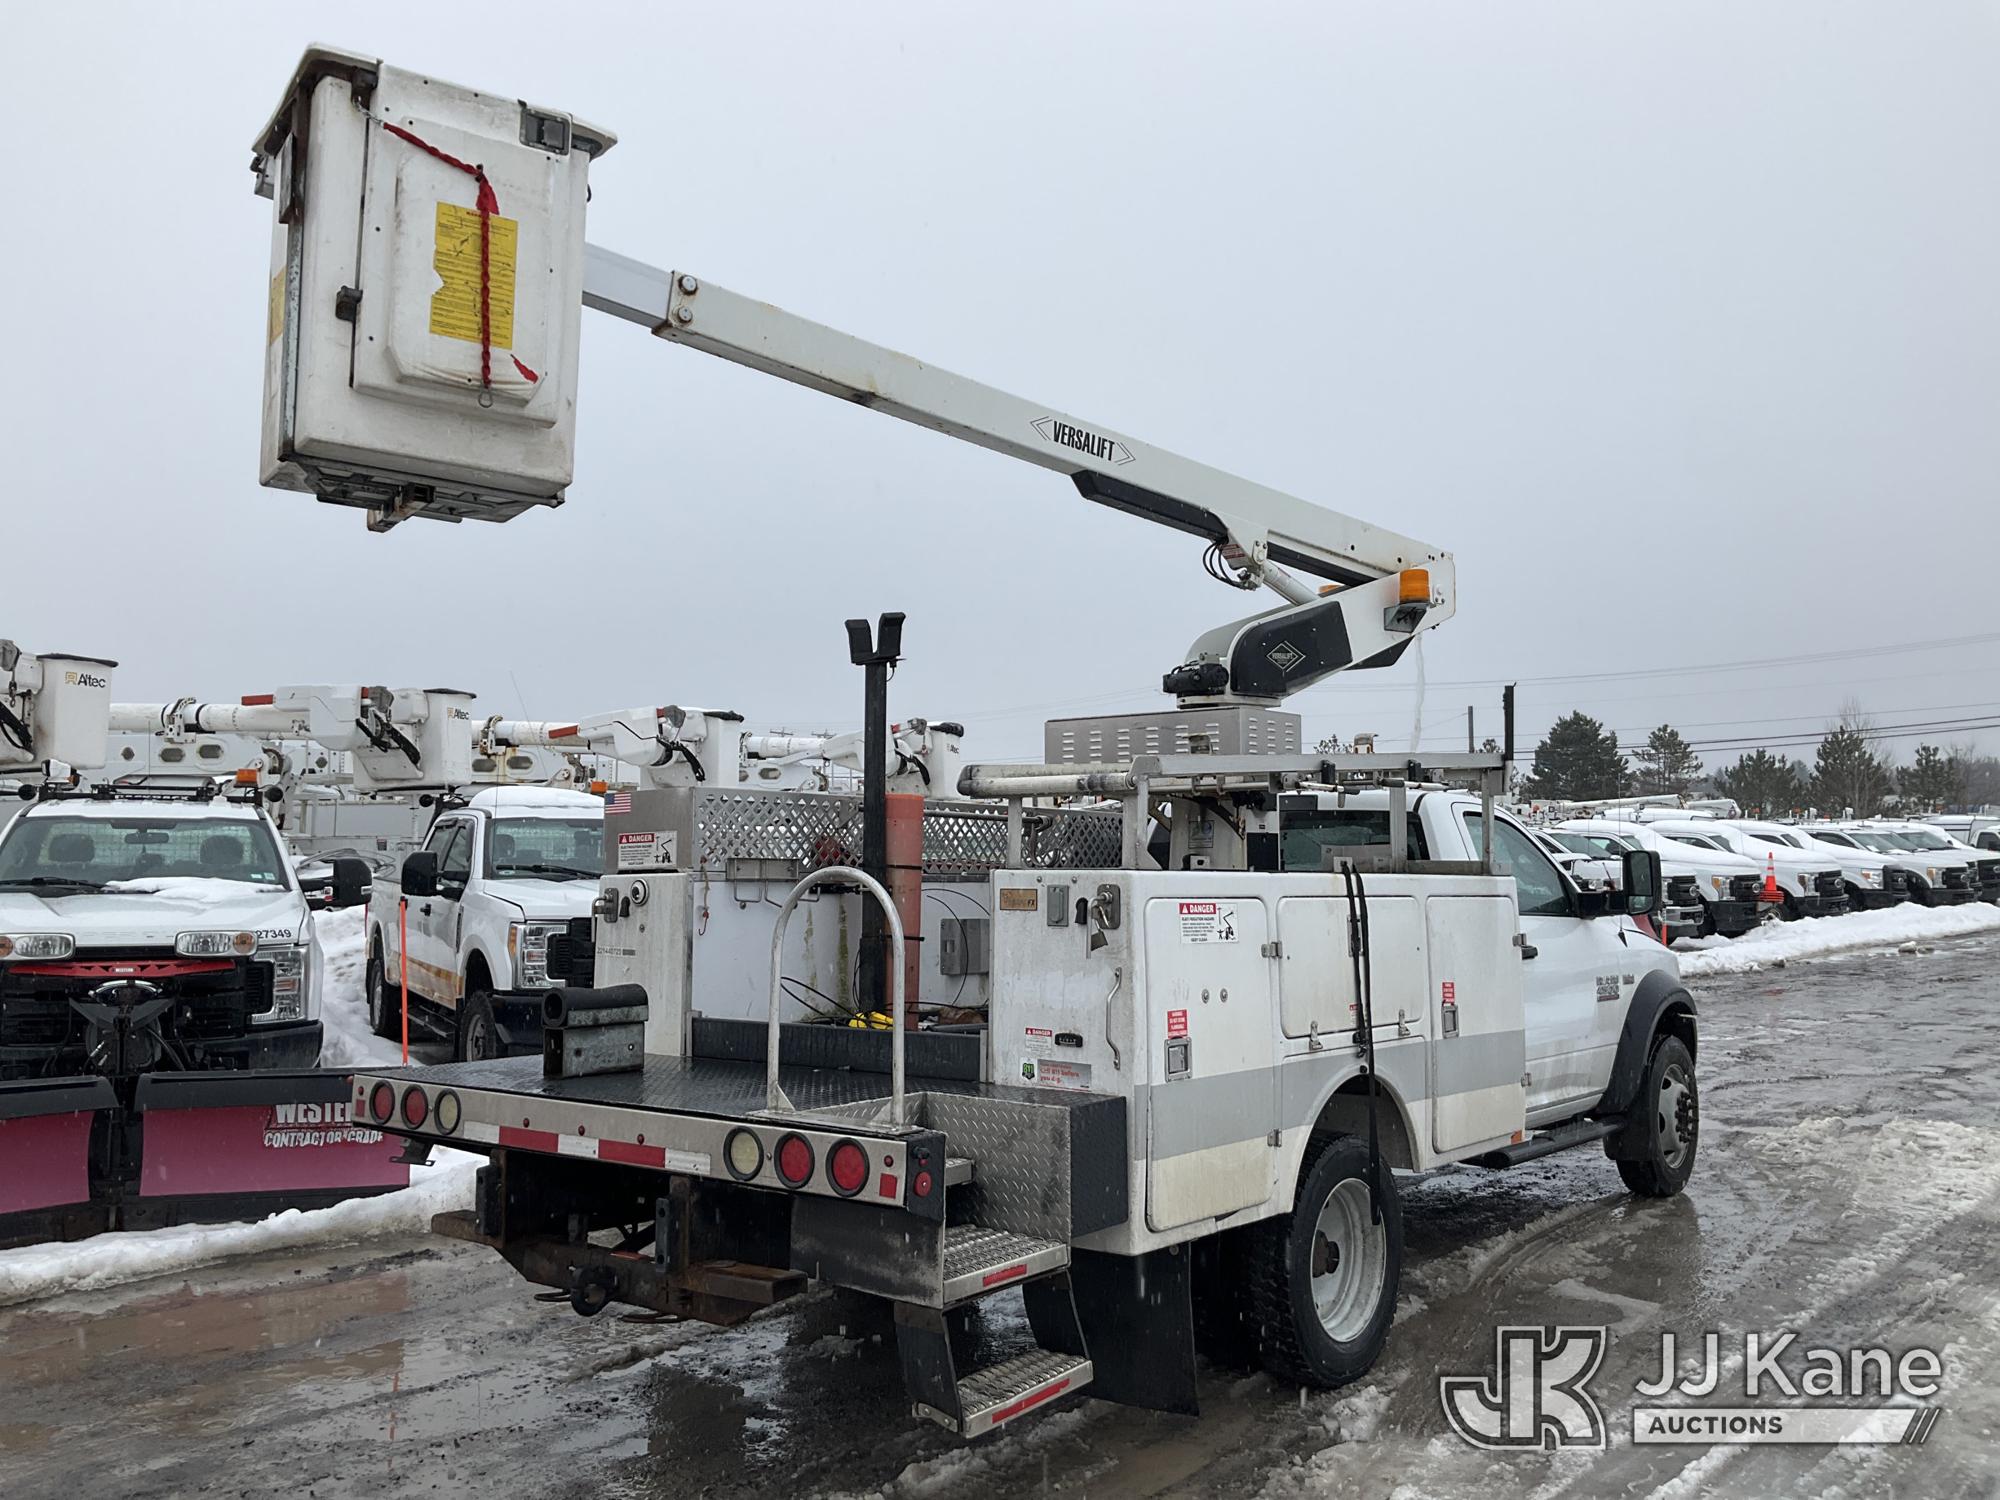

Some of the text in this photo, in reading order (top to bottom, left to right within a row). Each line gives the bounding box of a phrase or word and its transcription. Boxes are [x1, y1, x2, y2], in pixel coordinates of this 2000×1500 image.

[1053, 420, 1115, 461] VERSALIFT
[77, 673, 106, 688] Altec
[628, 834, 653, 843] DANGER
[1190, 904, 1214, 914] DANGER
[275, 1102, 353, 1123] WESTE
[263, 1131, 342, 1148] CONTRACTOR
